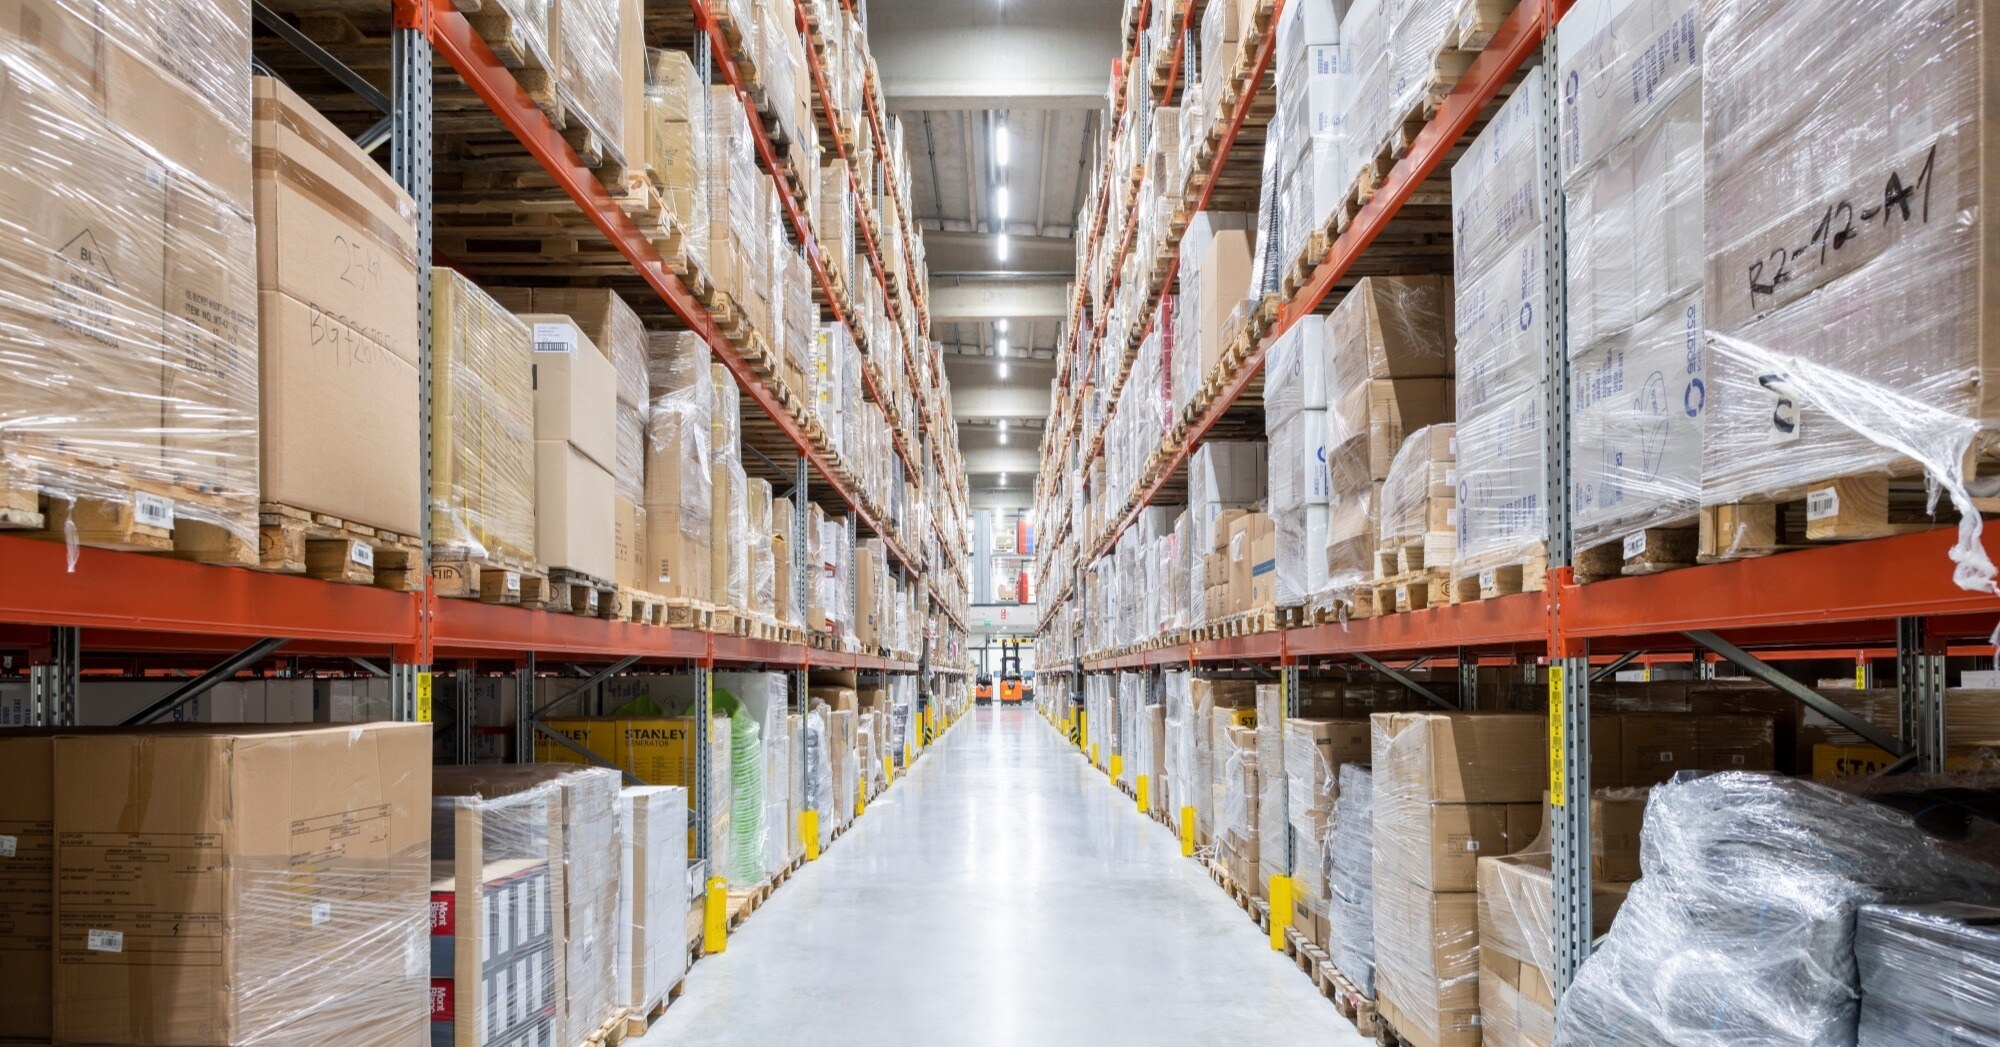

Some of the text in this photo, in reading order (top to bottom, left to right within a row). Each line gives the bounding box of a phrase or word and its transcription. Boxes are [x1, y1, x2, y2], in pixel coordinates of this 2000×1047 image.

[1687, 304, 1696, 374] sparco
[625, 729, 687, 740] STANLEY
[625, 740, 669, 748] GENERATOR
[439, 902, 448, 927] Mont
[437, 987, 446, 1012] Mont
